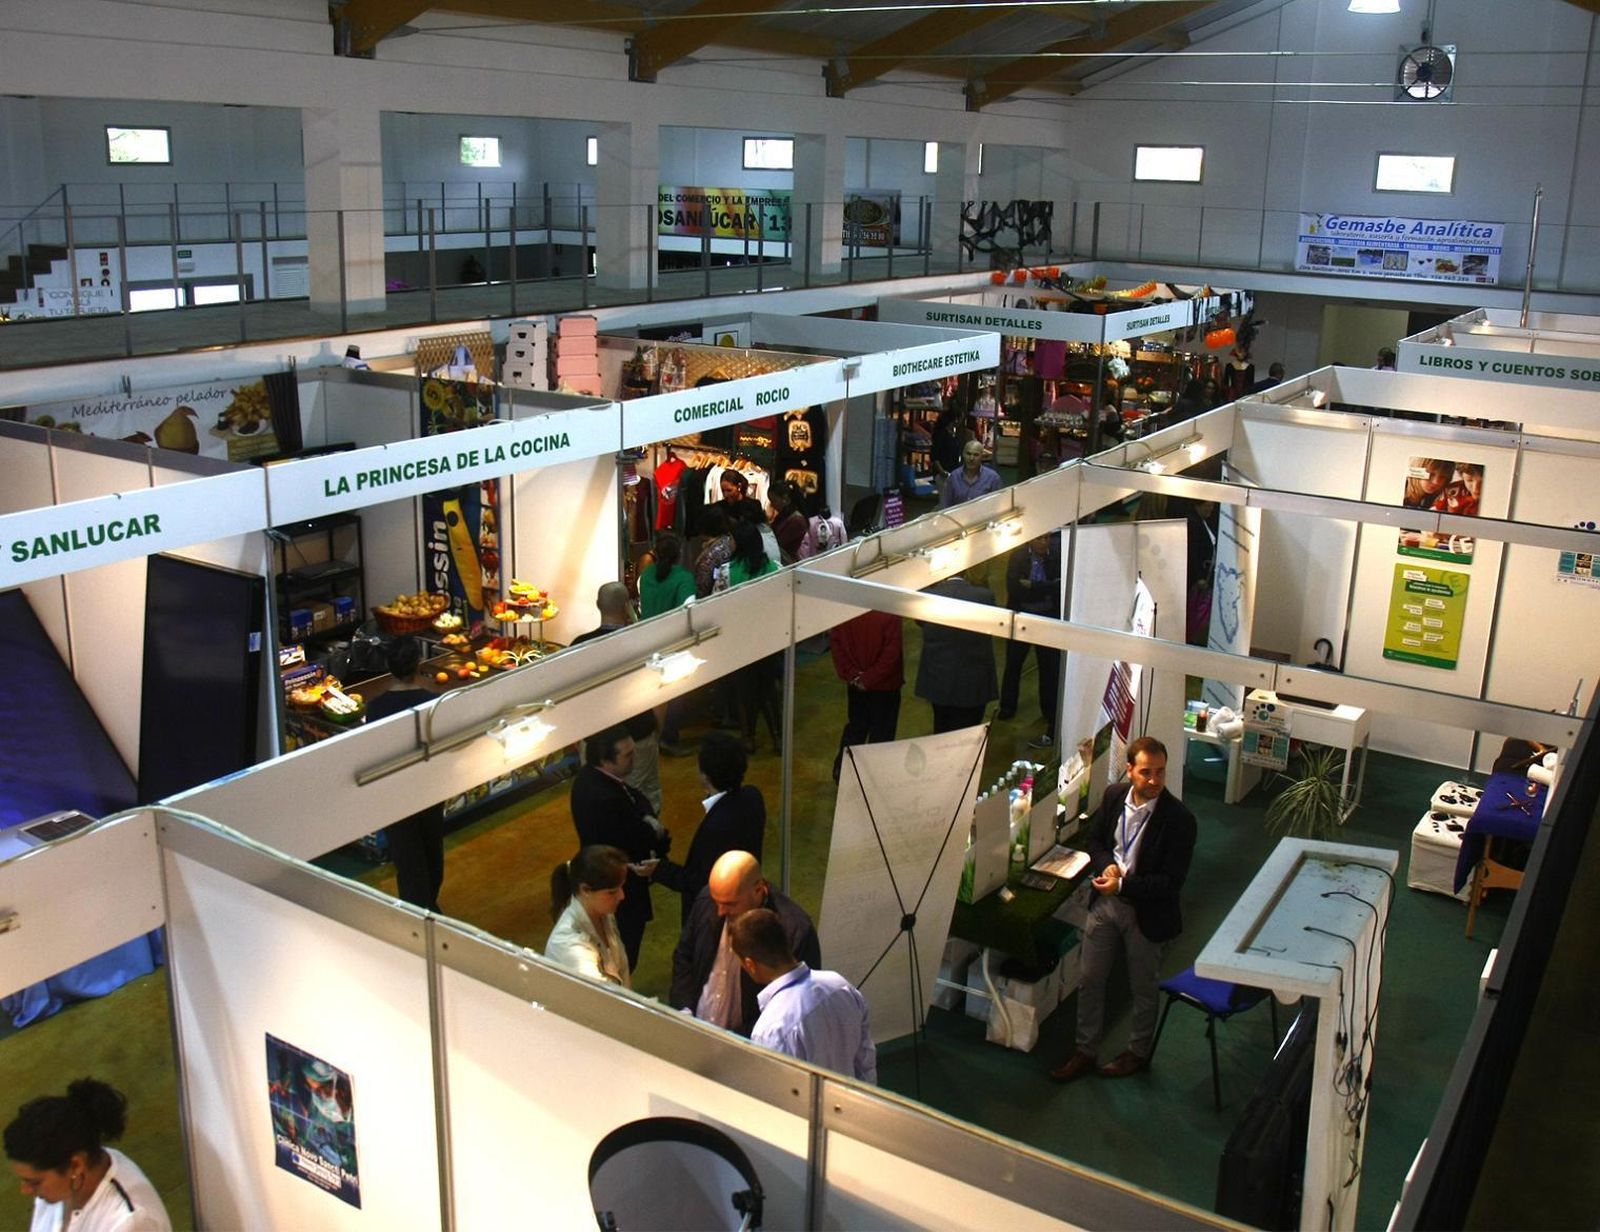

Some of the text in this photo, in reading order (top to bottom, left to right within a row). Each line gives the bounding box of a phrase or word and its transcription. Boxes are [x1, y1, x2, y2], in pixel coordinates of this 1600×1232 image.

[658, 193, 674, 203] DEL
[675, 194, 721, 204] COMERCIO
[722, 195, 730, 205] Y
[732, 196, 743, 205] LA
[1325, 216, 1493, 239] Gemasbe Analítica
[926, 311, 1043, 331] SURTISAN DETALLES
[1126, 314, 1171, 331] SURTISAN DETALLES
[893, 350, 981, 377] BIOTHECARE ESTETIKA
[1419, 355, 1474, 371] LIBROS
[1478, 361, 1489, 372] Y
[1492, 362, 1566, 379] CUENTOS
[71, 387, 226, 419] Mediterráneo pelador
[674, 386, 791, 424] COMERCIAL ROCIO
[324, 432, 571, 497] LA PRINCESA DE LA COCINA
[11, 513, 162, 563] SANLUCAR
